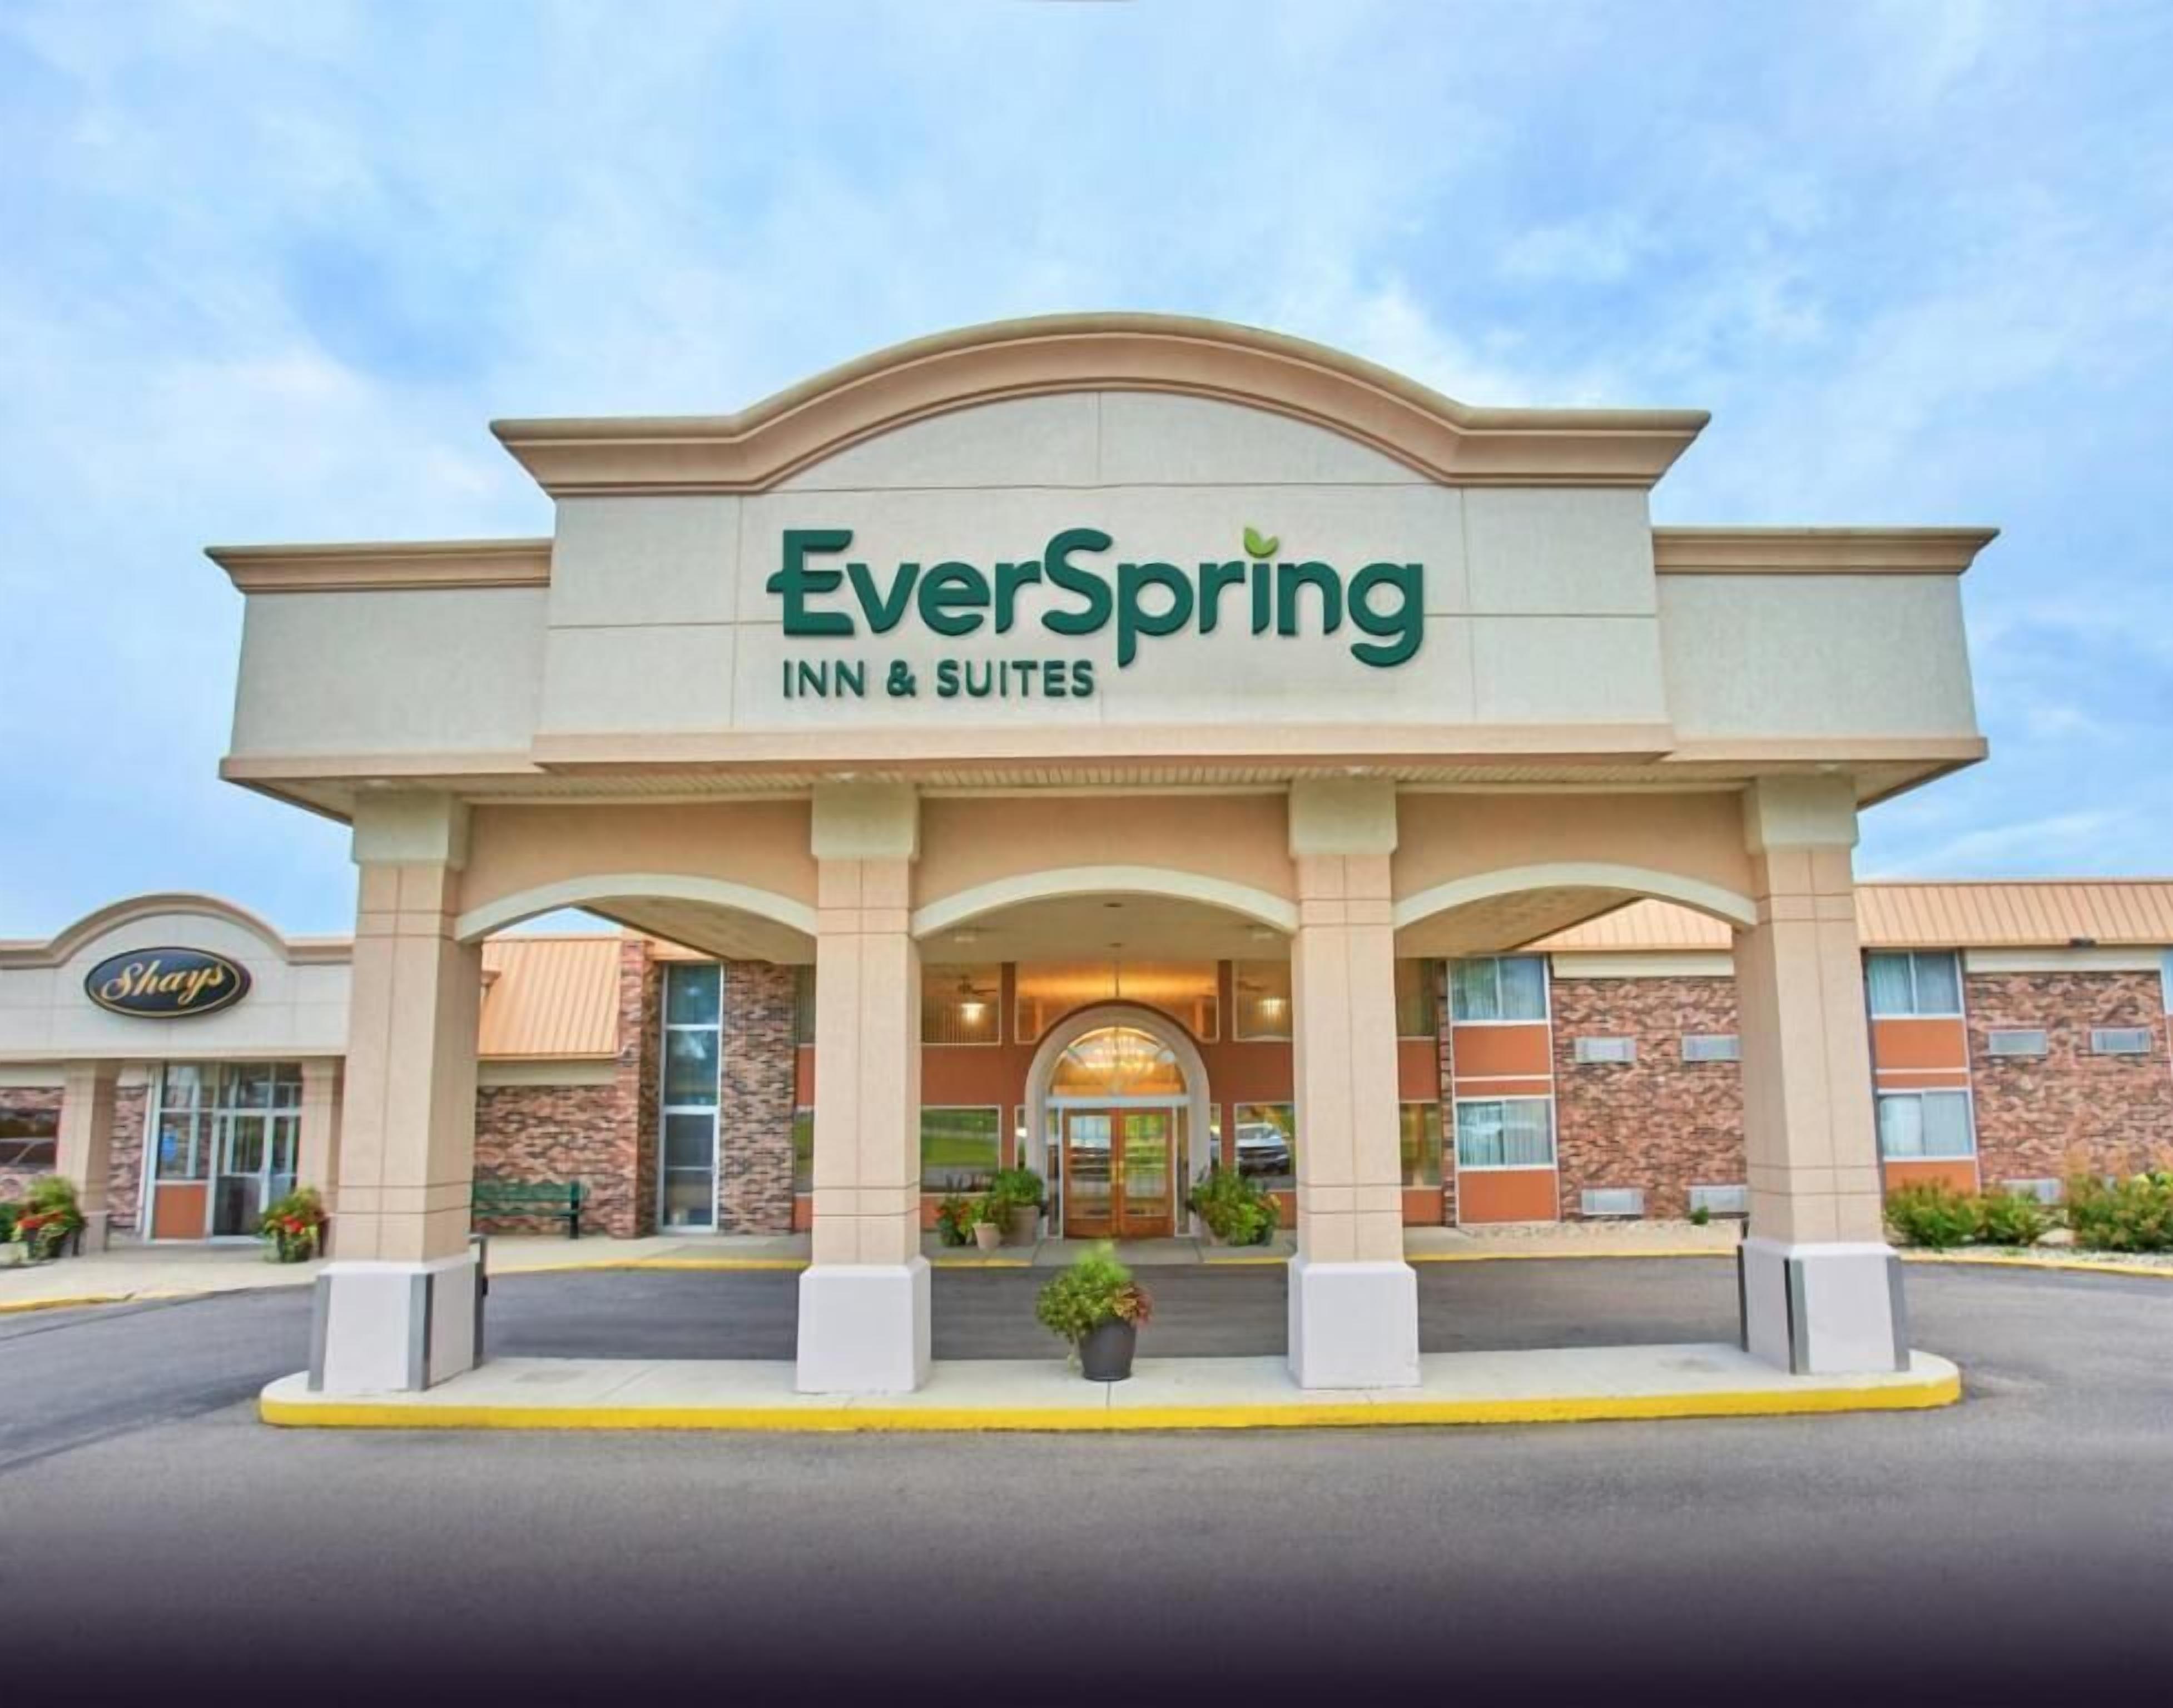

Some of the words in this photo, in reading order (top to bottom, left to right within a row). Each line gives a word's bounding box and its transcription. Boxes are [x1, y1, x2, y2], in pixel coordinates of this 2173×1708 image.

[766, 527, 1424, 667] EverSpring
[783, 660, 865, 697] INN
[887, 660, 916, 697] &
[937, 660, 1094, 697] SUITES
